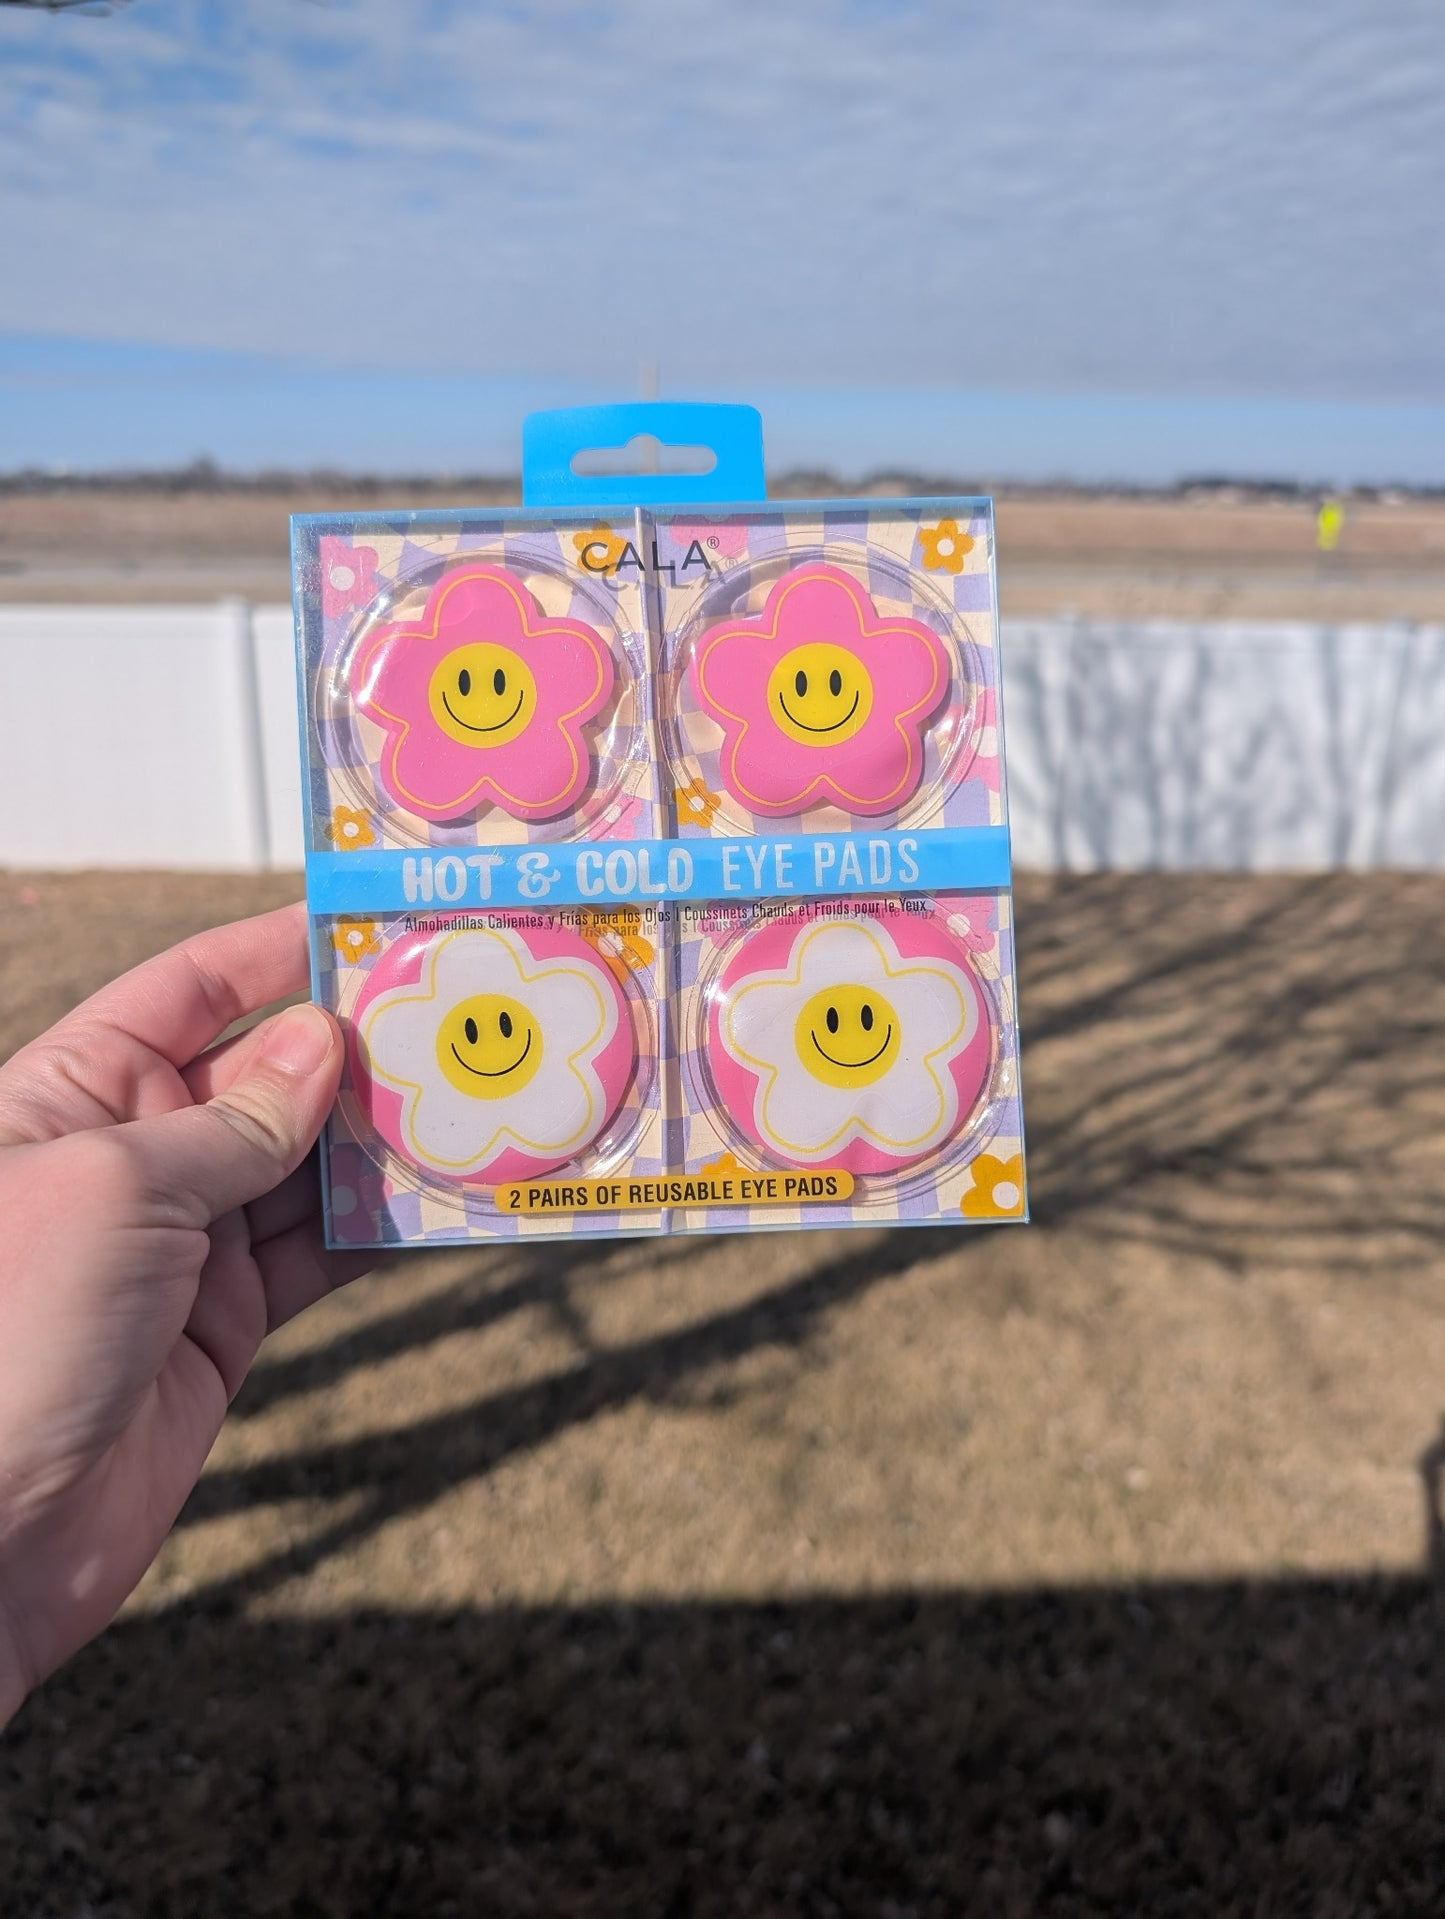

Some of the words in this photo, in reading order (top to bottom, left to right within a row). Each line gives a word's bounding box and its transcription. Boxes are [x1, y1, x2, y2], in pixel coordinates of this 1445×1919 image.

[402, 855, 502, 902] HOT
[516, 852, 560, 898] &
[576, 848, 694, 897] COLD
[722, 844, 793, 891] EYE
[814, 838, 919, 886] PADS
[405, 914, 483, 932] Almohadillas
[488, 912, 550, 930] Calientes
[549, 915, 556, 929] y
[560, 911, 588, 926] Frías
[593, 912, 617, 926] para
[623, 908, 641, 923] los
[645, 907, 671, 923] Ojos
[684, 904, 748, 921] Coussinets
[752, 902, 793, 918] Chauds
[798, 901, 810, 916] et
[814, 900, 850, 916] Froids
[854, 902, 880, 916] pour
[884, 898, 896, 912] le
[899, 897, 927, 912] Yeux
[510, 1190, 521, 1209] 2
[529, 1187, 588, 1207] PAIRS
[597, 1185, 621, 1204] OF
[629, 1179, 733, 1203] REUSABLE
[741, 1178, 777, 1199] EYE
[785, 1176, 837, 1197] PADS
